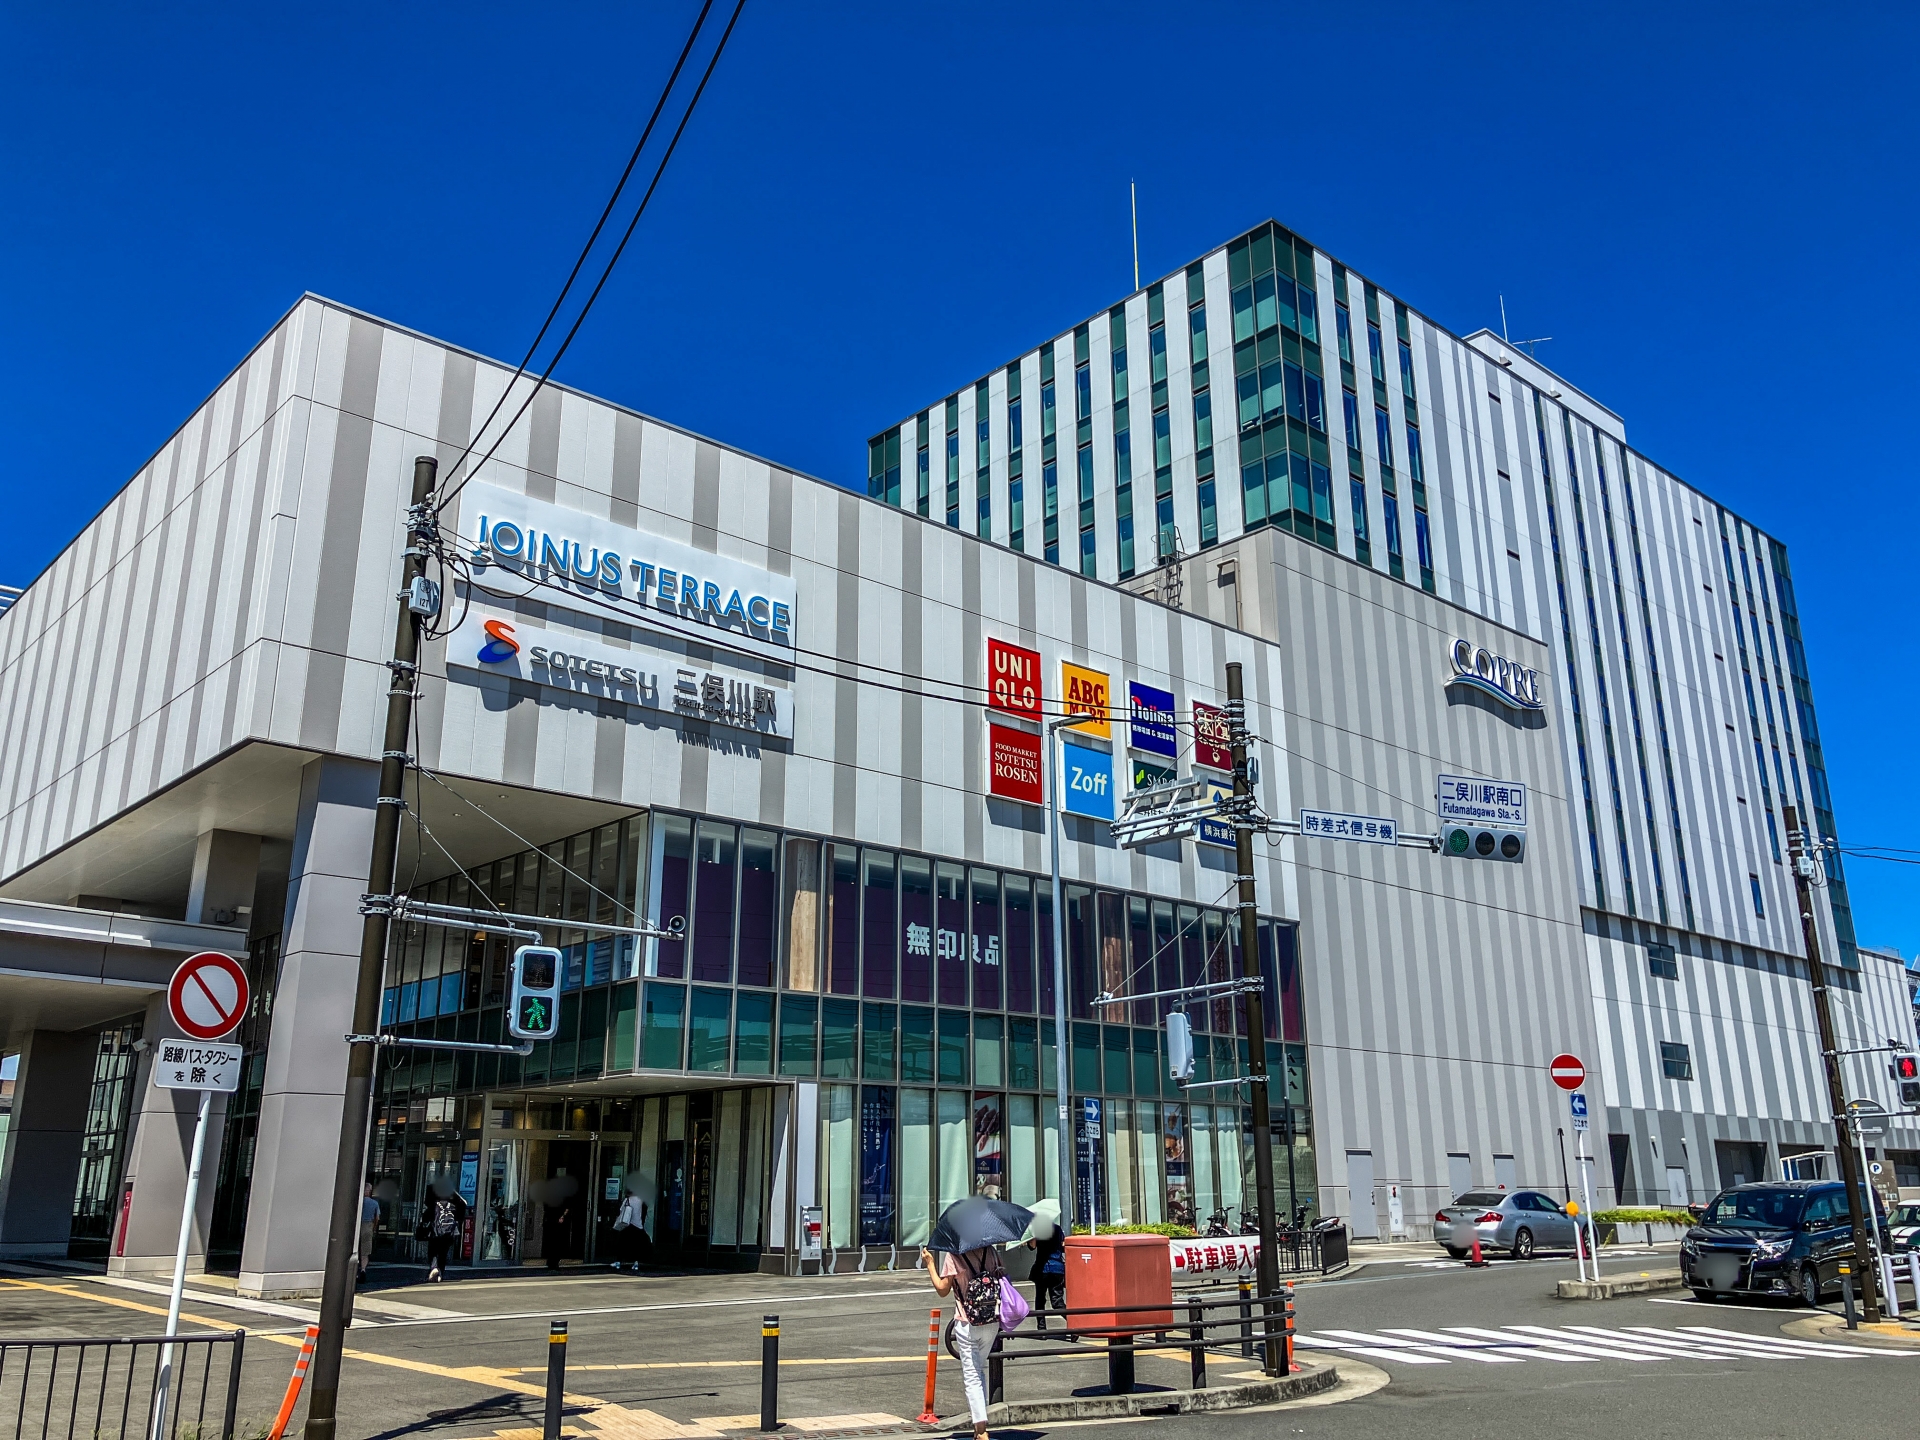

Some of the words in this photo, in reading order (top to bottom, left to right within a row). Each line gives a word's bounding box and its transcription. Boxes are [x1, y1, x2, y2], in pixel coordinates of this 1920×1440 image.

[472, 514, 621, 586] JOINUS
[630, 558, 790, 634] TERRACE
[529, 645, 658, 691] SOTETSU
[994, 649, 1031, 682] UNI
[1449, 638, 1542, 704] COPRE
[995, 678, 1035, 709] QLO
[1068, 675, 1105, 708] ABC
[994, 750, 1038, 770] SOTETSU
[995, 742, 1011, 752] FOOD
[1012, 746, 1038, 759] MARKET
[994, 762, 1038, 785] ROSEN
[1070, 766, 1108, 796] Zoff
[1442, 781, 1523, 807] 二俣川駅南口
[1443, 802, 1496, 818] Futamatagawa
[1497, 806, 1522, 821] Sta.-S.
[1204, 824, 1236, 842] 横浜銀行
[1305, 815, 1393, 840] 時差式信号機
[906, 921, 999, 966] 無印良品
[162, 1046, 238, 1066] 路線バス・タクシー
